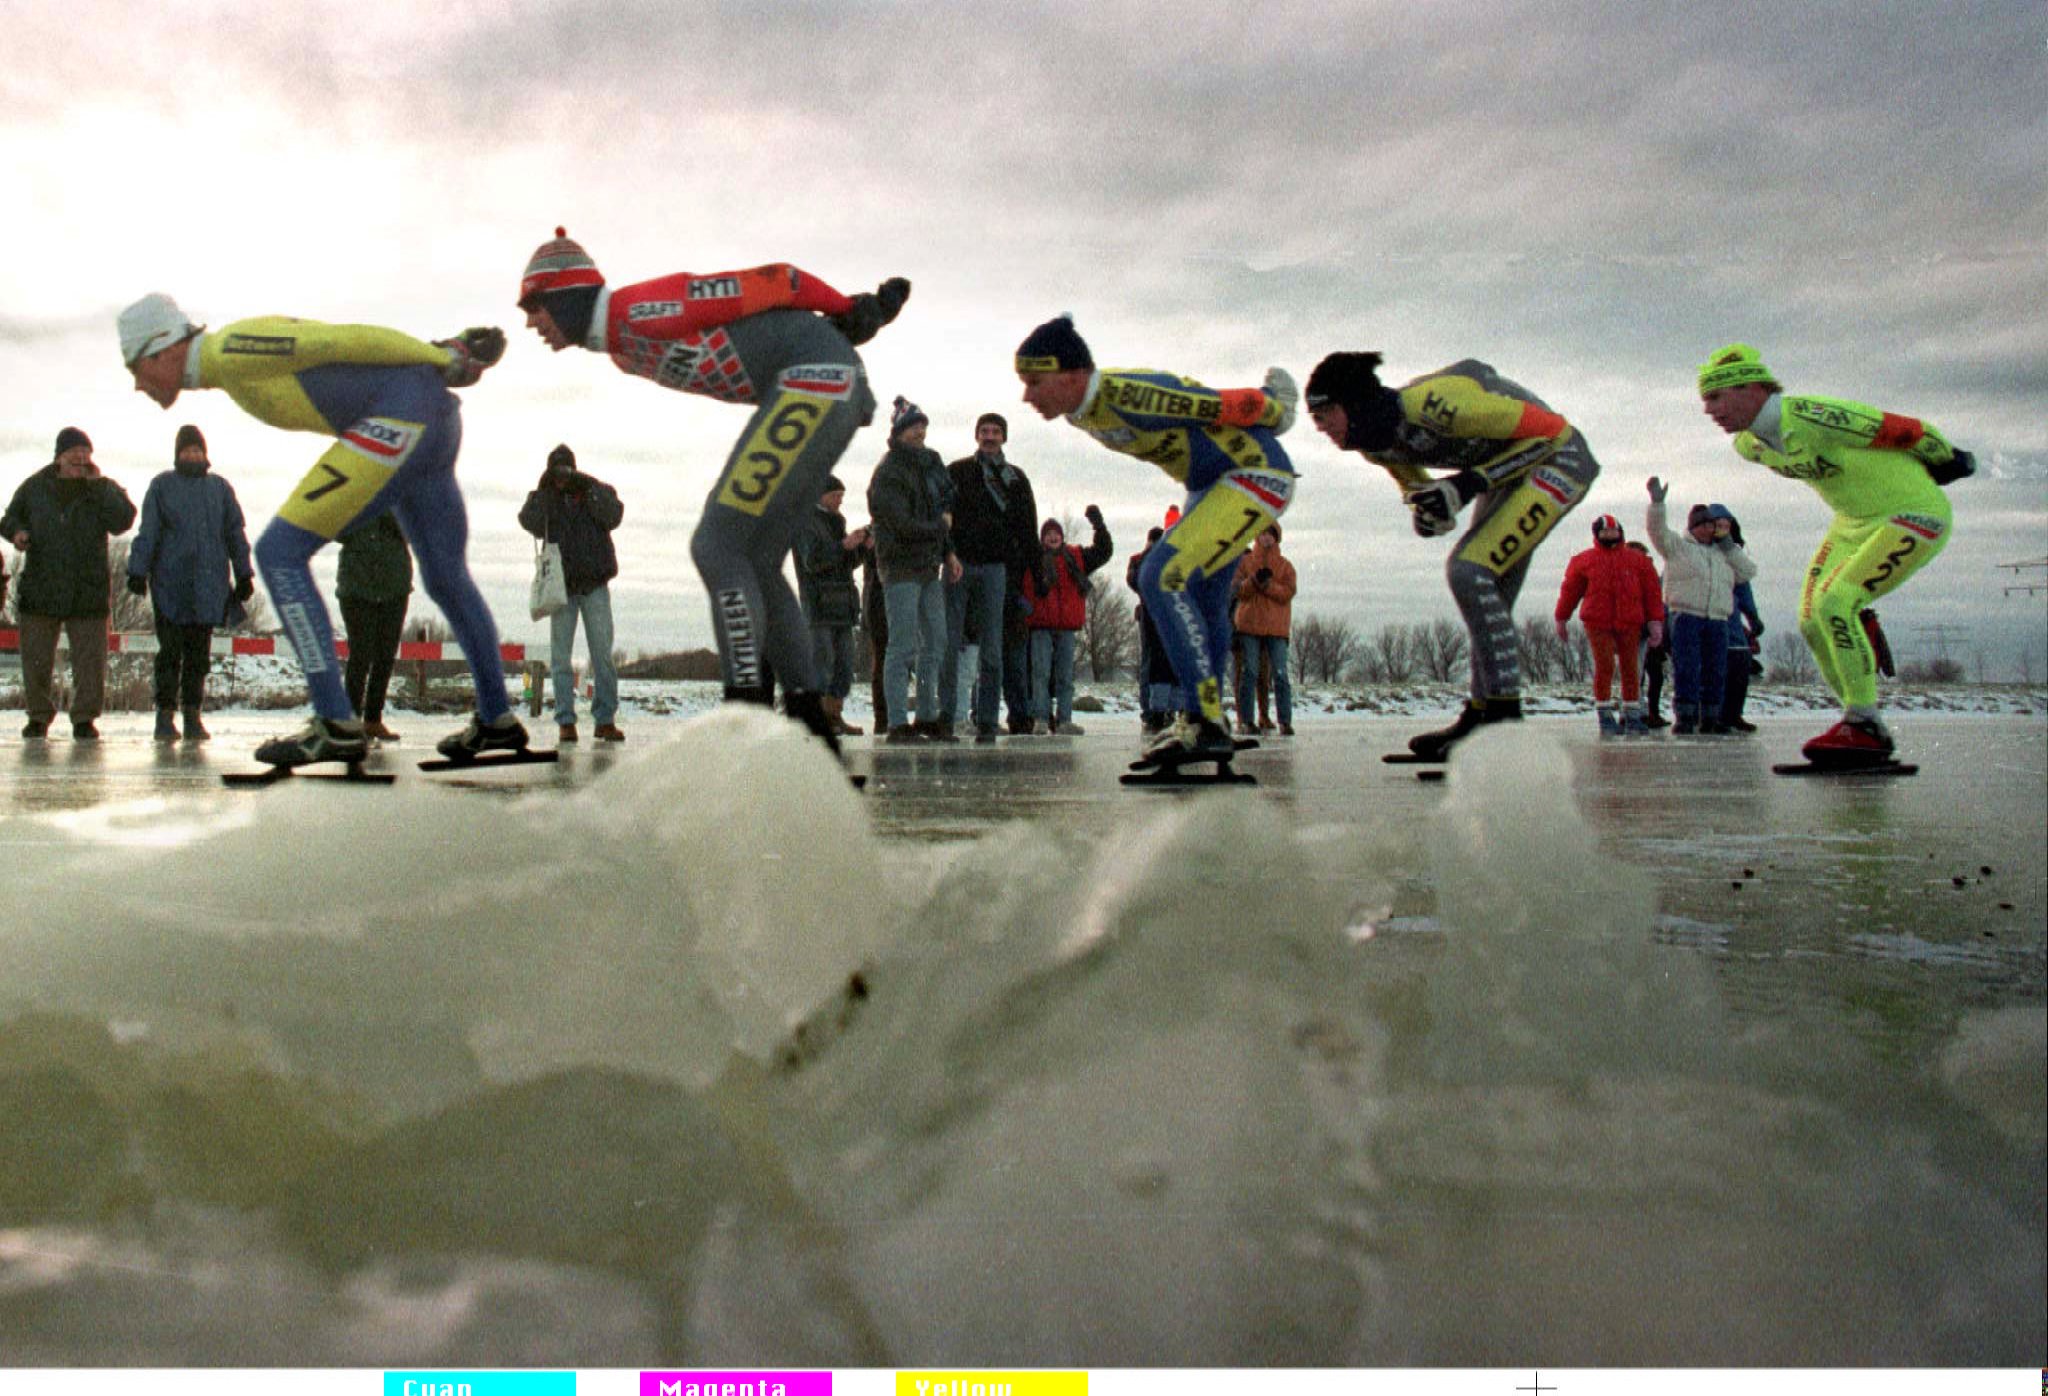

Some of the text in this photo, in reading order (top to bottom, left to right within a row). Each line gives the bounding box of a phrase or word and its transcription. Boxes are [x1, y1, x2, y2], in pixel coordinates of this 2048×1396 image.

[1121, 381, 1193, 421] BUITER
[304, 463, 351, 501] 7
[1862, 535, 1917, 593] 22
